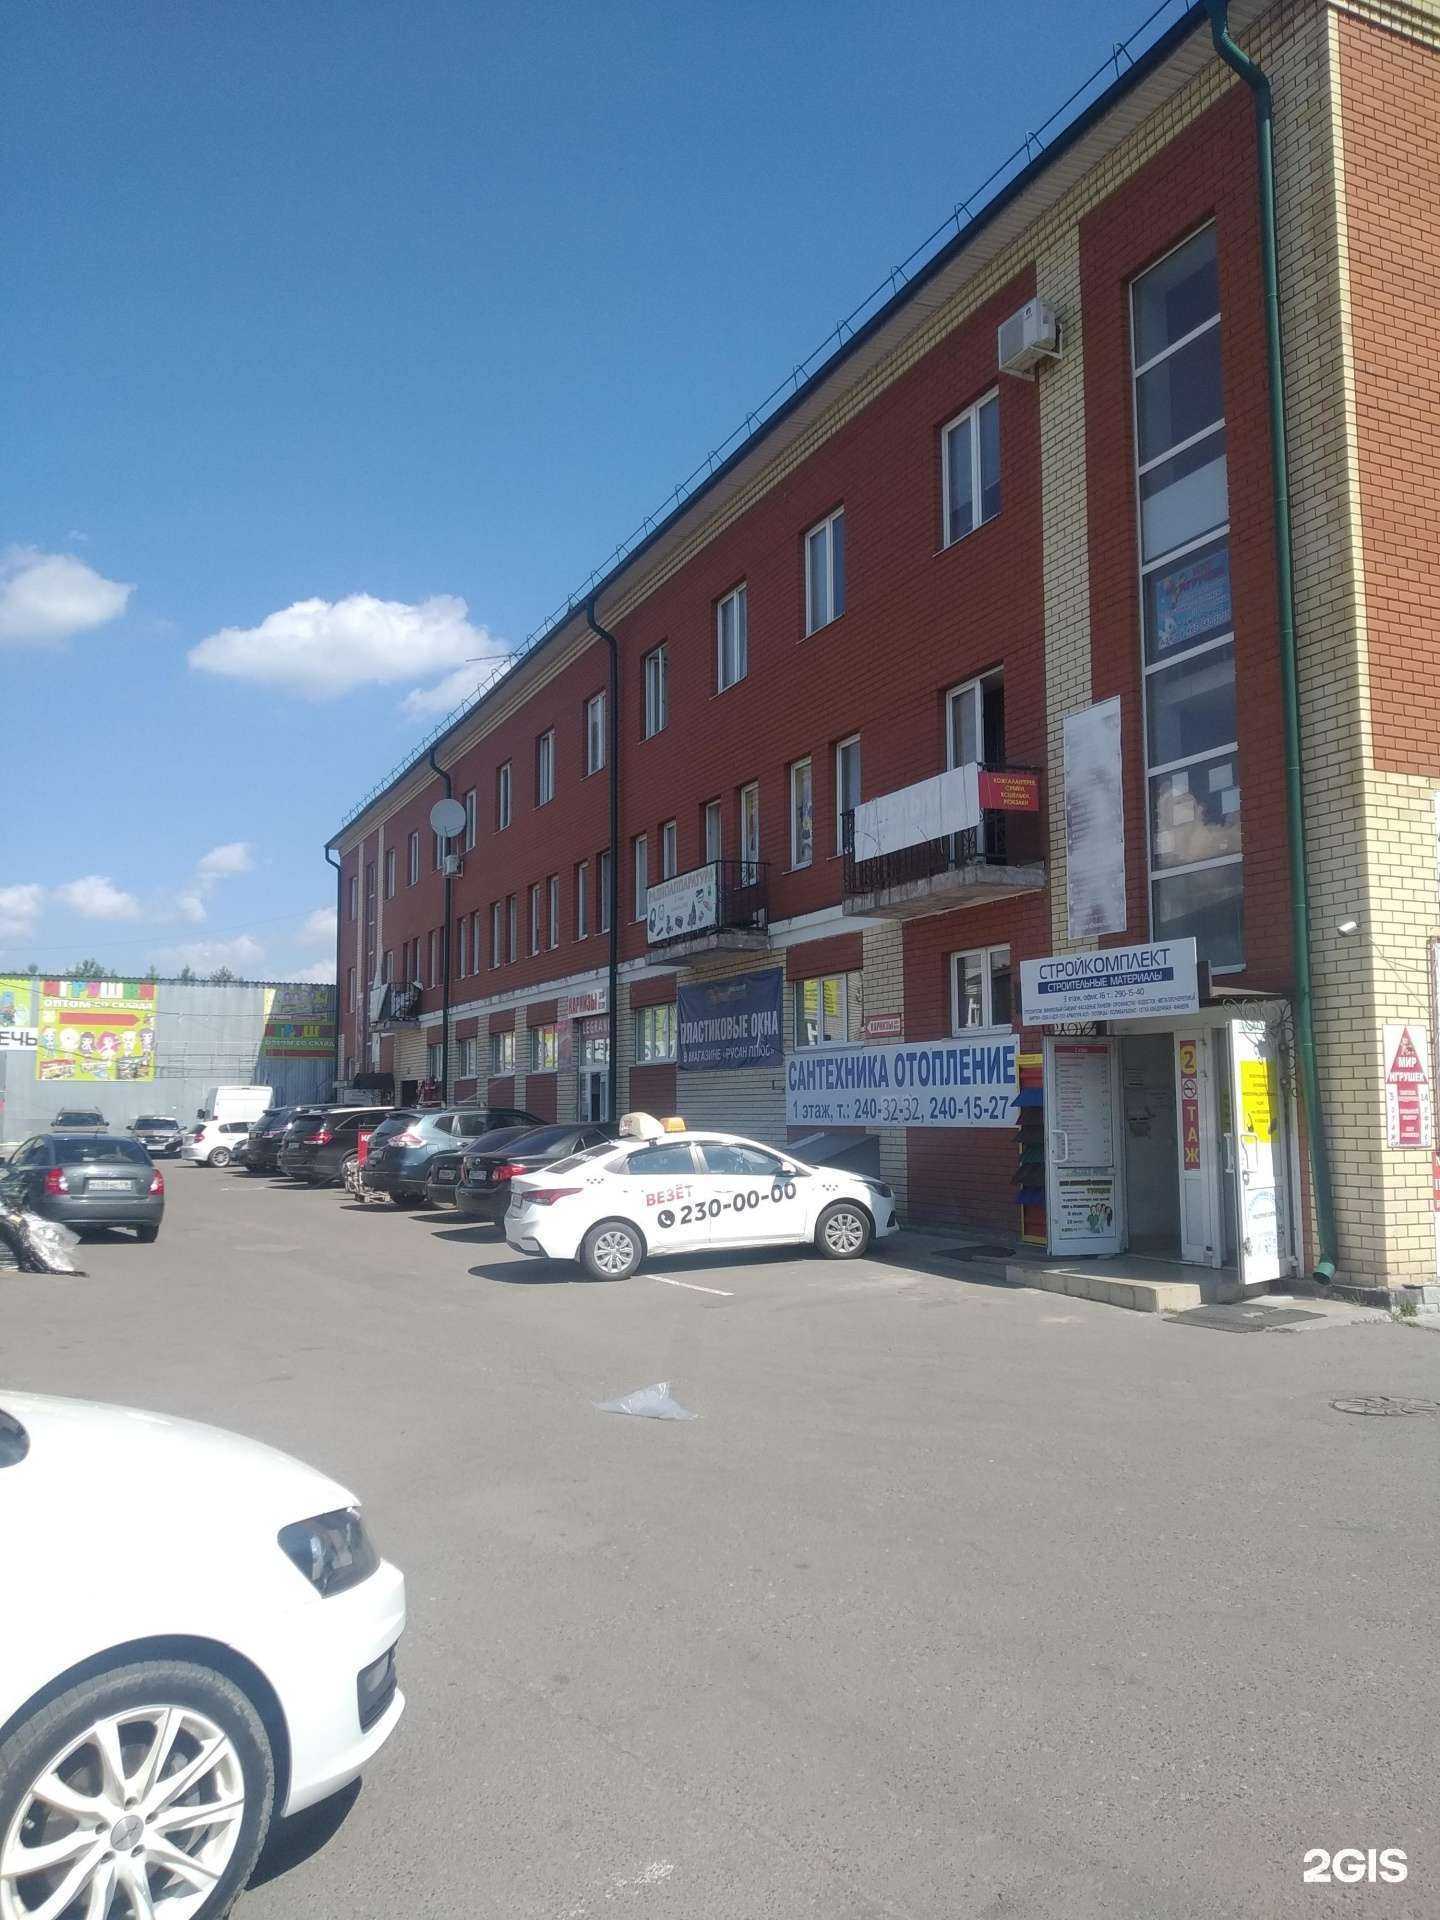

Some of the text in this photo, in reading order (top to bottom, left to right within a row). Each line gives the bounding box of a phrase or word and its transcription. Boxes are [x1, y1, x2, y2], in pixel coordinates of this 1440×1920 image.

[1039, 949, 1170, 979] СТРОЙКОМПЛЕКТ
[1047, 971, 1163, 993] СТРОИТЕЛЬНЫЕ МАТЕРИАЛЫ
[680, 1011, 779, 1045] ПЛАСТИКОВЫЕ ОКНА
[788, 1045, 1016, 1092] САНТЕХНИКА ОТОПЛЕНИЕ
[1184, 1051, 1194, 1068] 2
[1399, 1056, 1418, 1068] МИР
[1389, 1072, 1426, 1083] ИГРУШЕК
[793, 1101, 799, 1119] 1
[802, 1102, 833, 1121] этаж,
[855, 1096, 925, 1122] 240-32-32,
[930, 1096, 1009, 1120] 240-15-27
[646, 1184, 693, 1207] ВЕЗЁТ
[680, 1181, 797, 1225] 230-00-00
